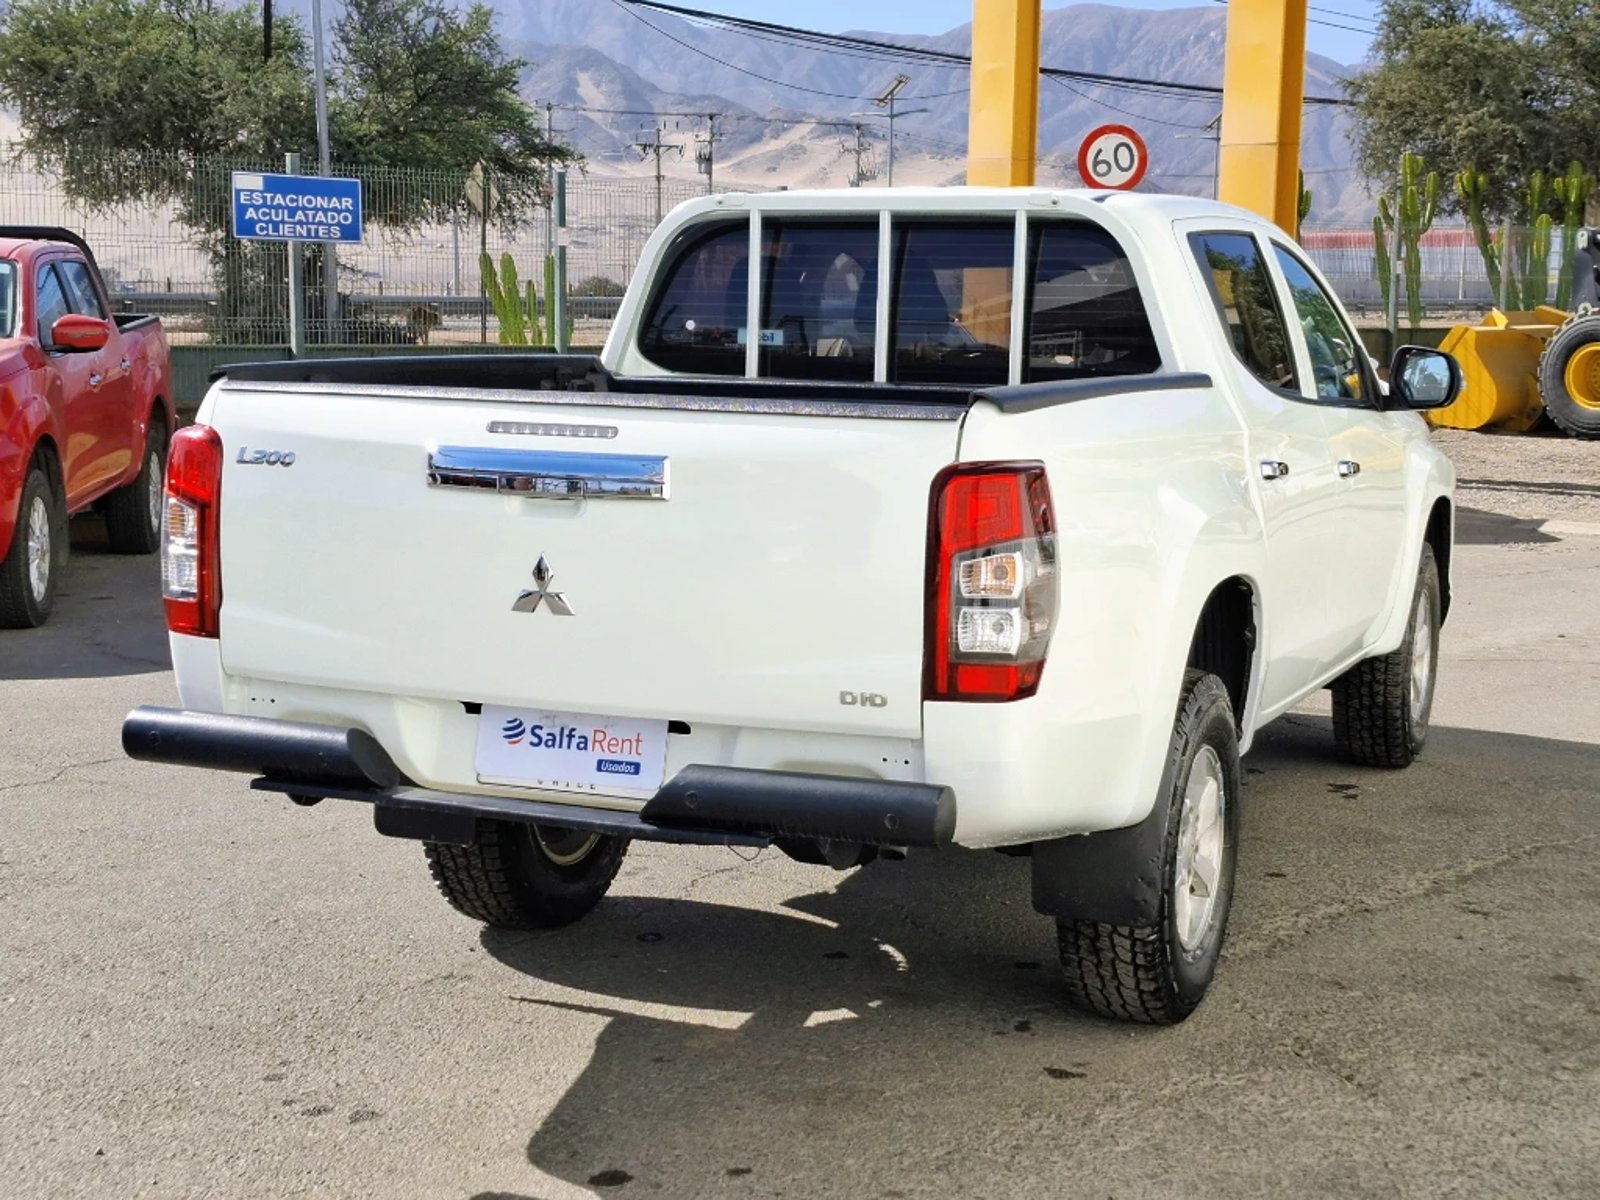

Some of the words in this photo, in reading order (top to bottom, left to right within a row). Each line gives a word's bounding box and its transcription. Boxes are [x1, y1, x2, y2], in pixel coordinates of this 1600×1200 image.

[1092, 141, 1135, 177] 60
[240, 191, 354, 210] ESTACIONAR
[245, 207, 353, 224] ACULATADO
[255, 222, 341, 239] CLIENTES
[236, 446, 296, 468] L200
[601, 760, 636, 774] Usados
